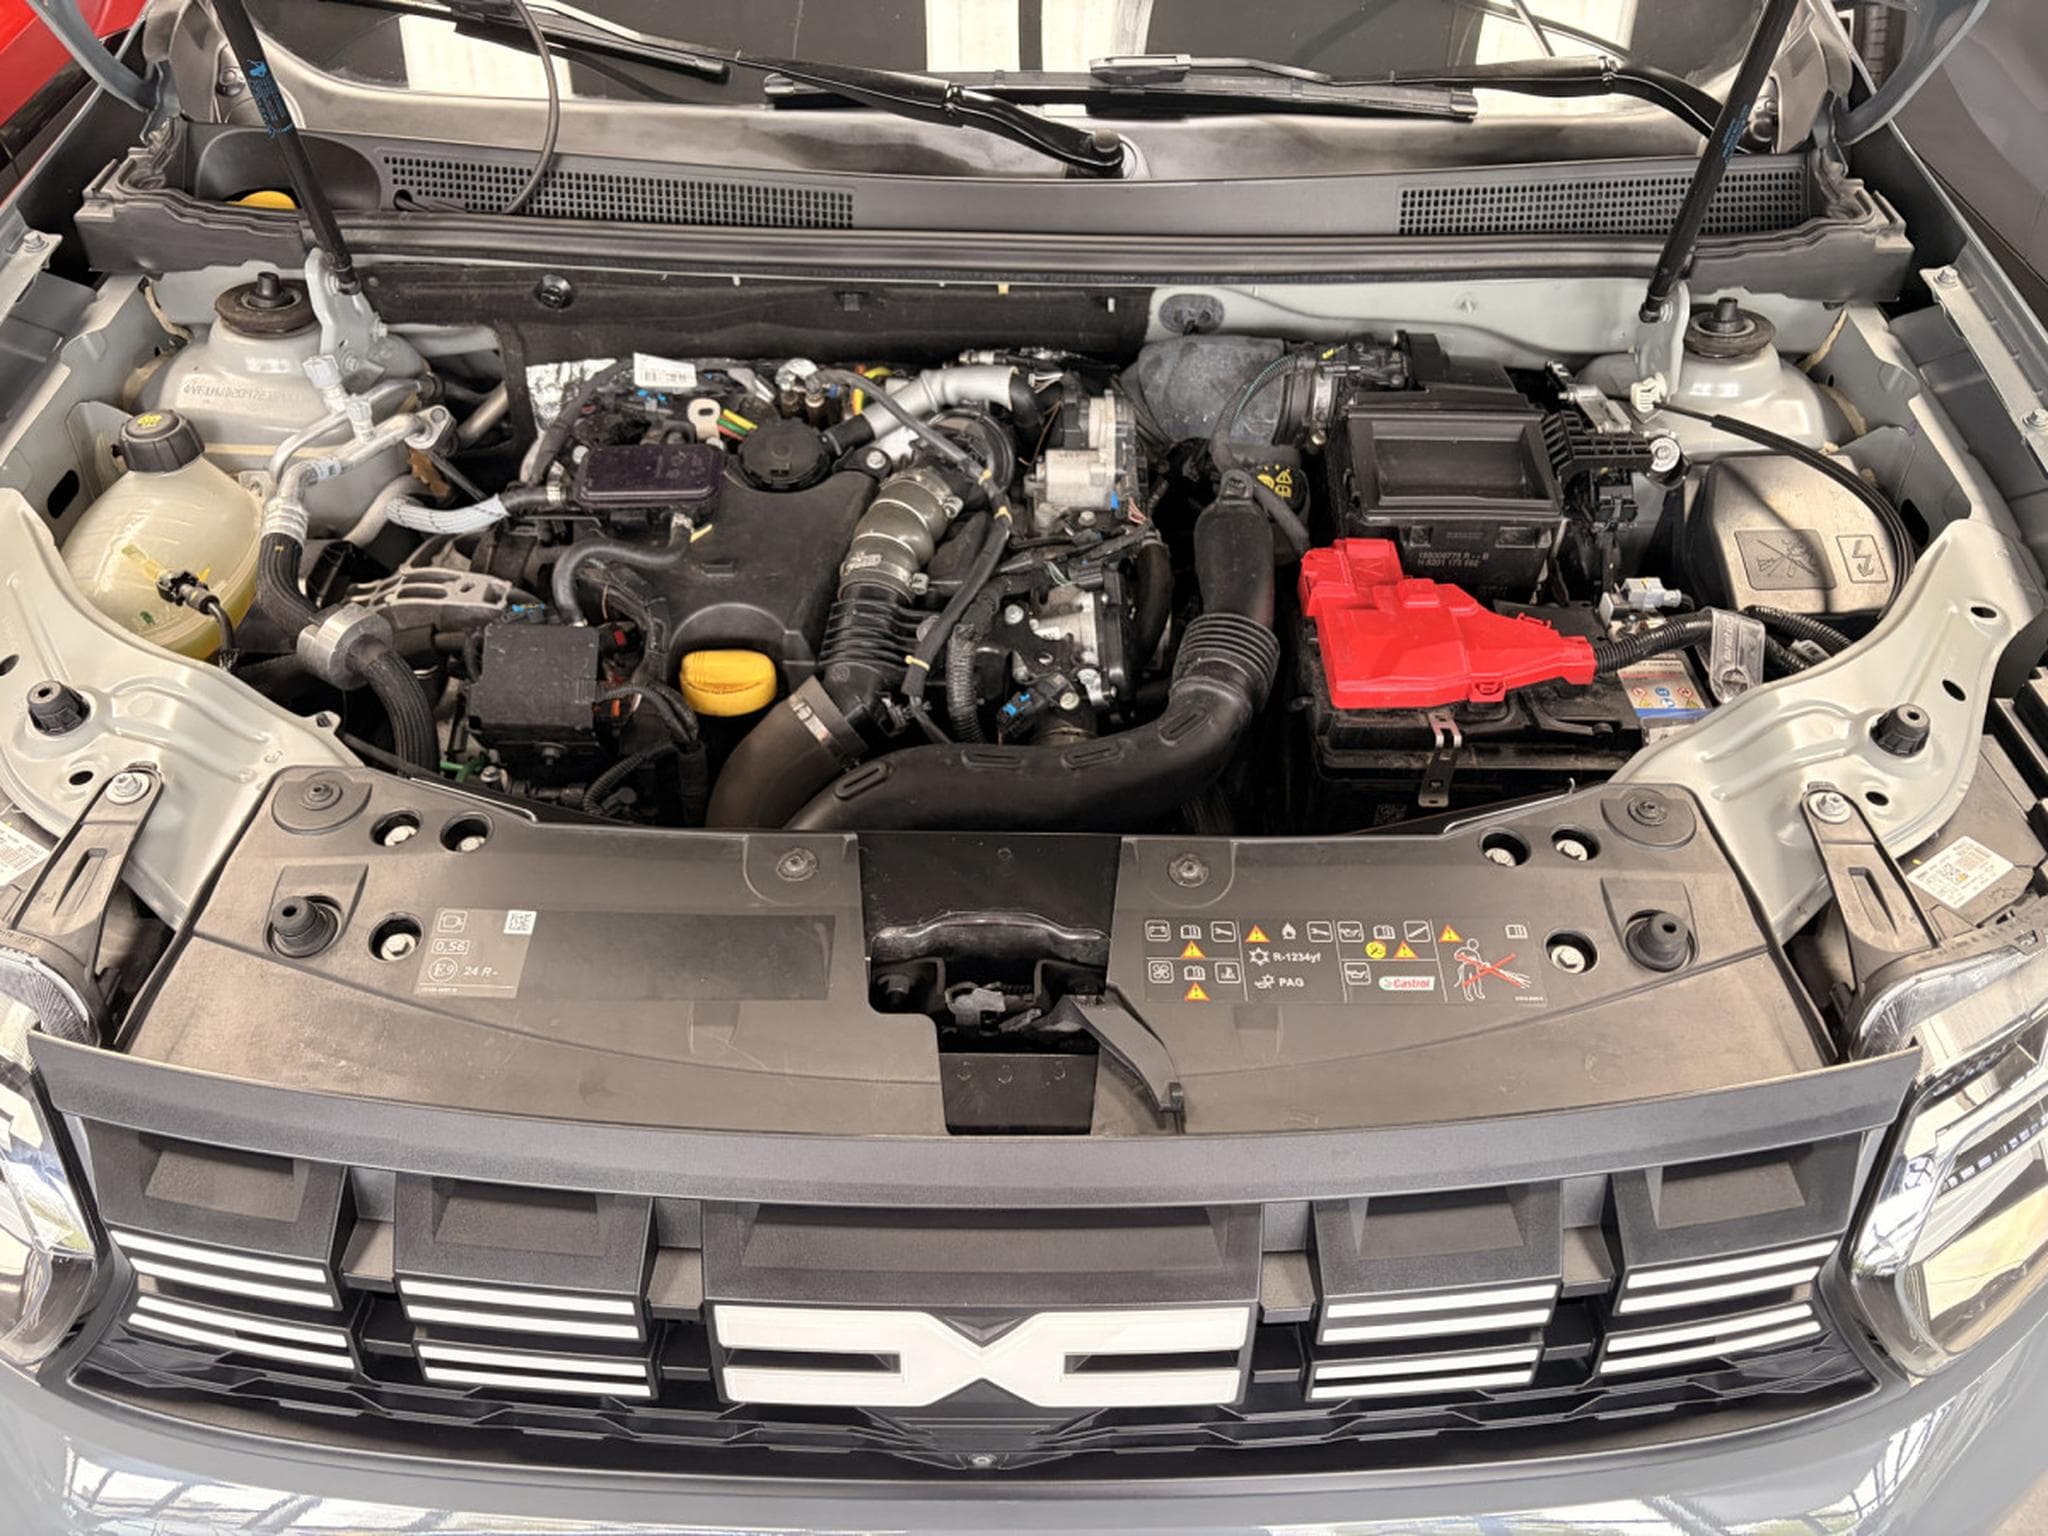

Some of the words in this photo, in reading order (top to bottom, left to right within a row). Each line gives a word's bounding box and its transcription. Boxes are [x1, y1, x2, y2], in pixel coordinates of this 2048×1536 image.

[435, 941, 465, 953] 0,56
[1273, 952, 1321, 963] R-1234yf
[433, 963, 455, 977] E9
[1279, 977, 1305, 988] PAG
[1394, 979, 1430, 989] Castrol
